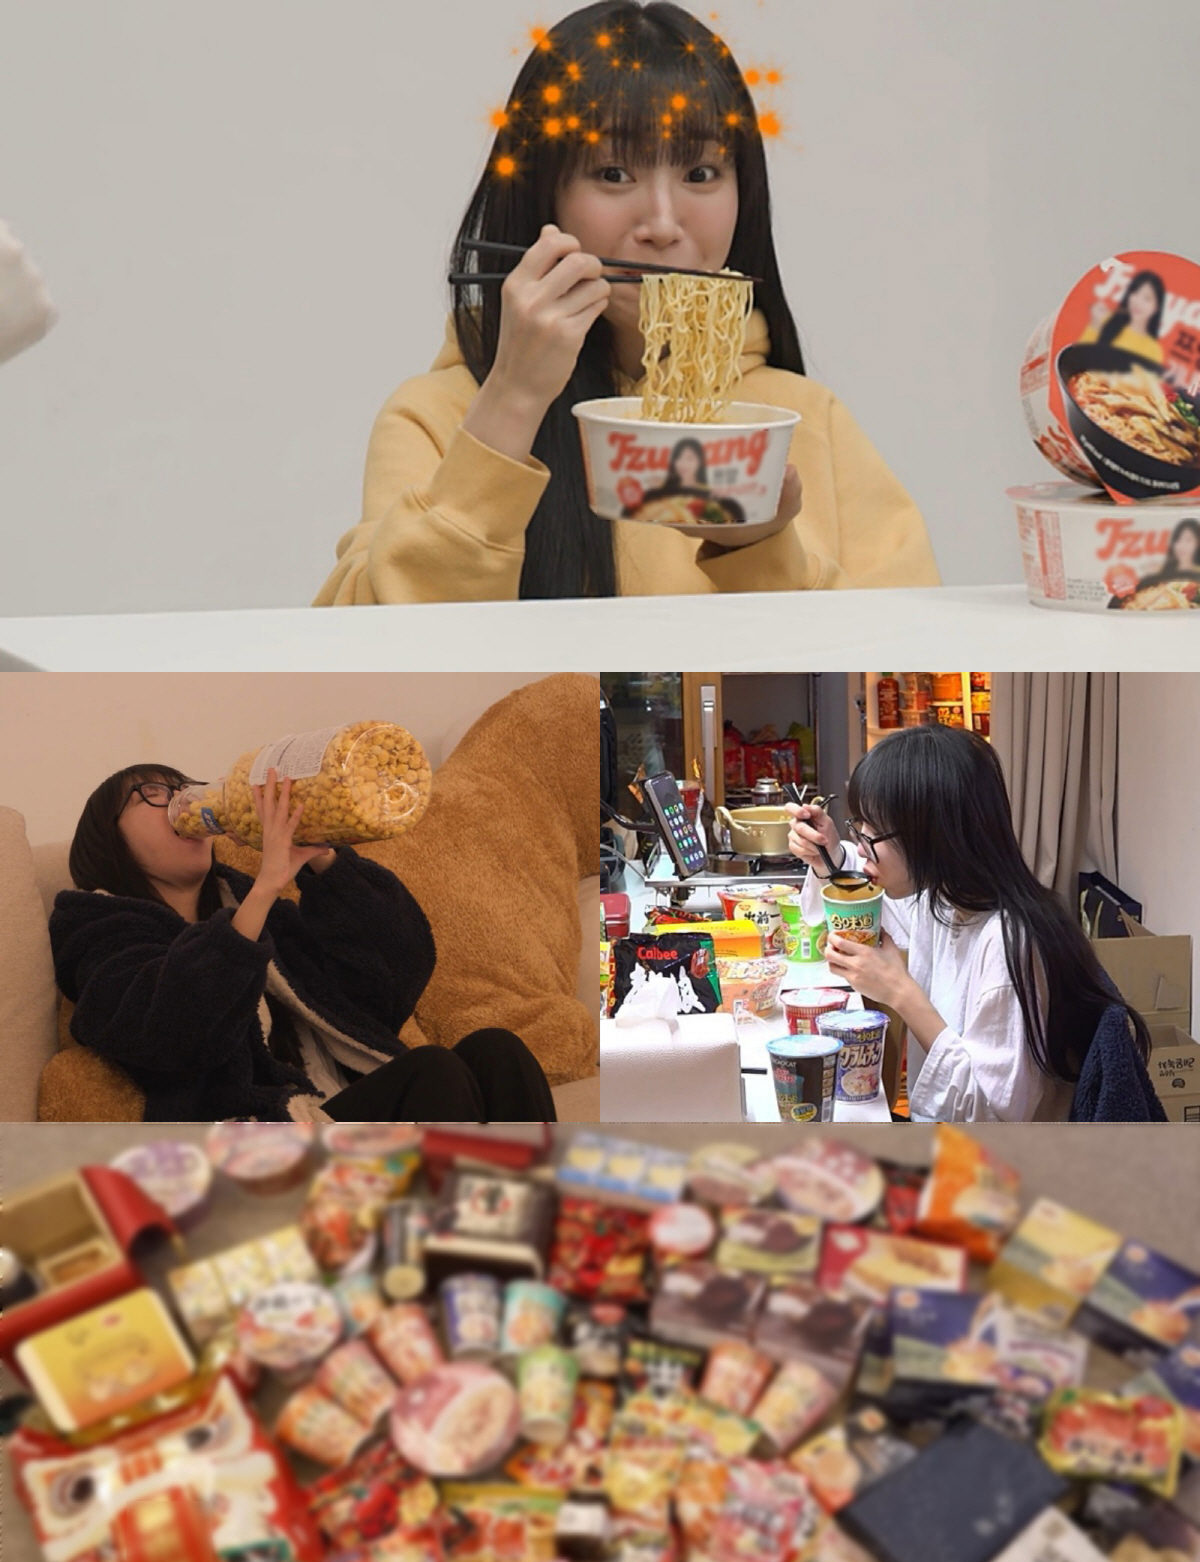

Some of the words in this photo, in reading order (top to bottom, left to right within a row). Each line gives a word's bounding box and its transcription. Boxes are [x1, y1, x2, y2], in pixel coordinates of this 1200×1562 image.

[607, 428, 770, 475] Tzuang
[1096, 517, 1172, 560] Tzu
[637, 945, 679, 960] Calbee
